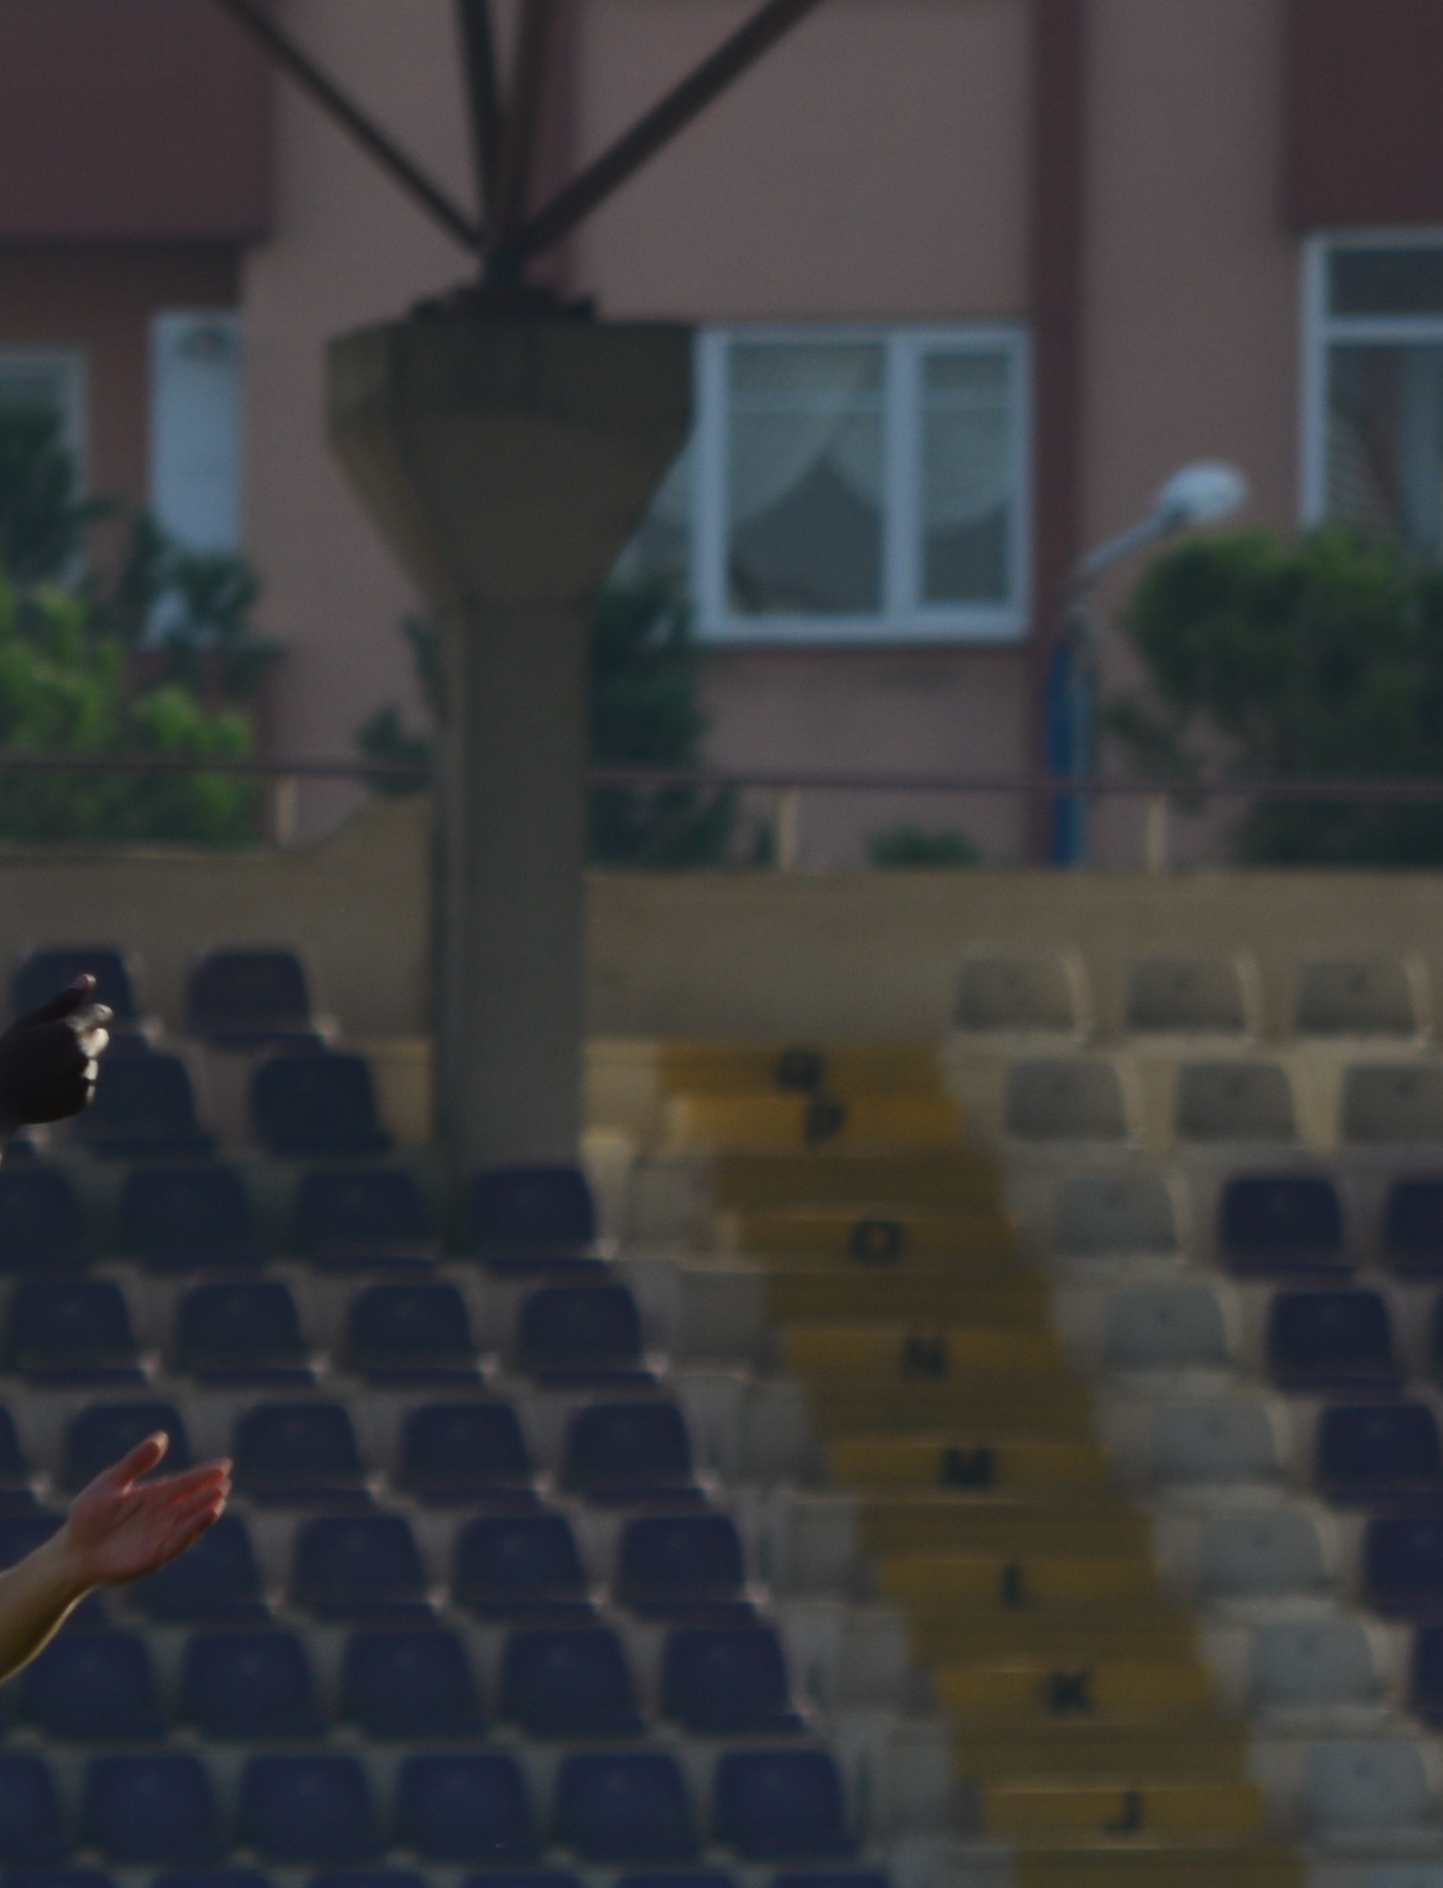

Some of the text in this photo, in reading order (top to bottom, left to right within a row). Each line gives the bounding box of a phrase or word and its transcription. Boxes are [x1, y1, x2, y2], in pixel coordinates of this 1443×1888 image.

[940, 1448, 996, 1490] M
[1049, 1674, 1090, 1714] K
[1103, 1791, 1145, 1837] J
